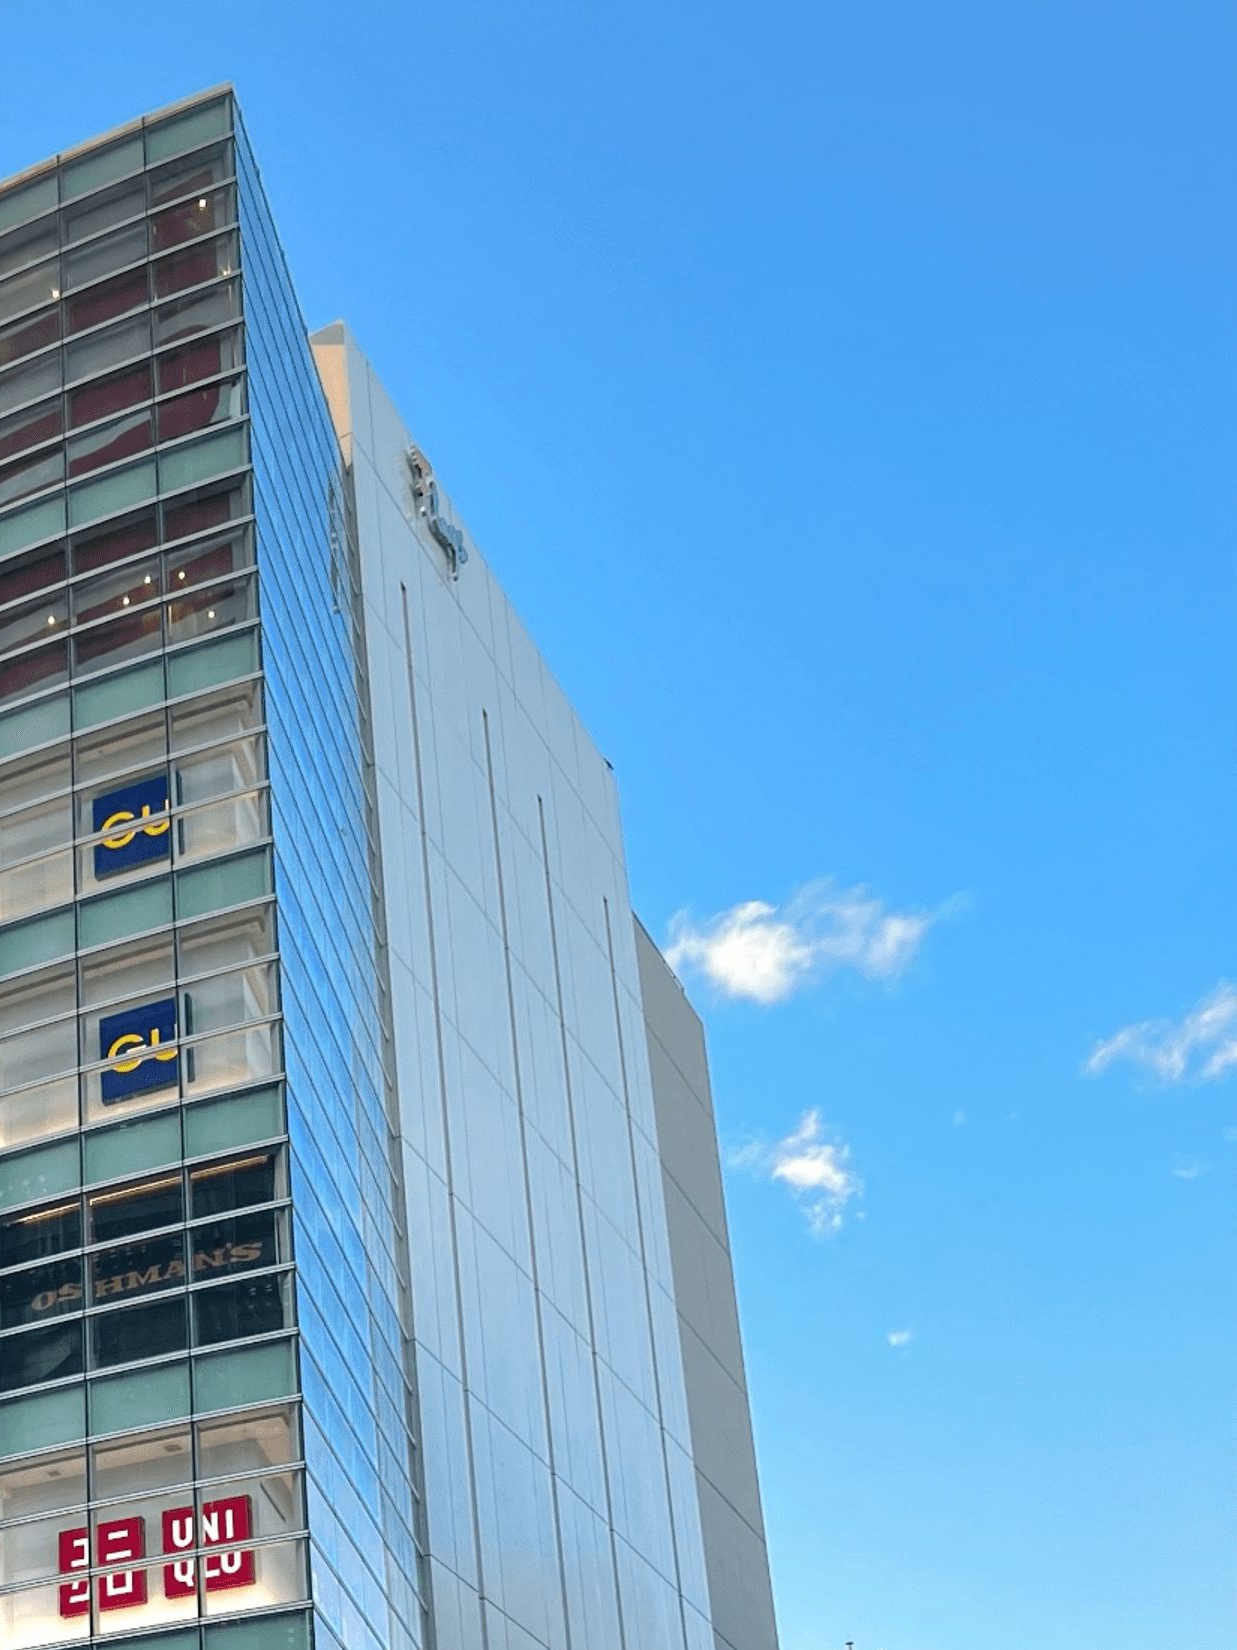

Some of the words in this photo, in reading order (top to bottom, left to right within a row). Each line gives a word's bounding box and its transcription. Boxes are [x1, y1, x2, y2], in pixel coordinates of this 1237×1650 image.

[99, 798, 171, 851] GU
[108, 1022, 178, 1074] GU
[32, 1241, 263, 1312] OSHMAN'S
